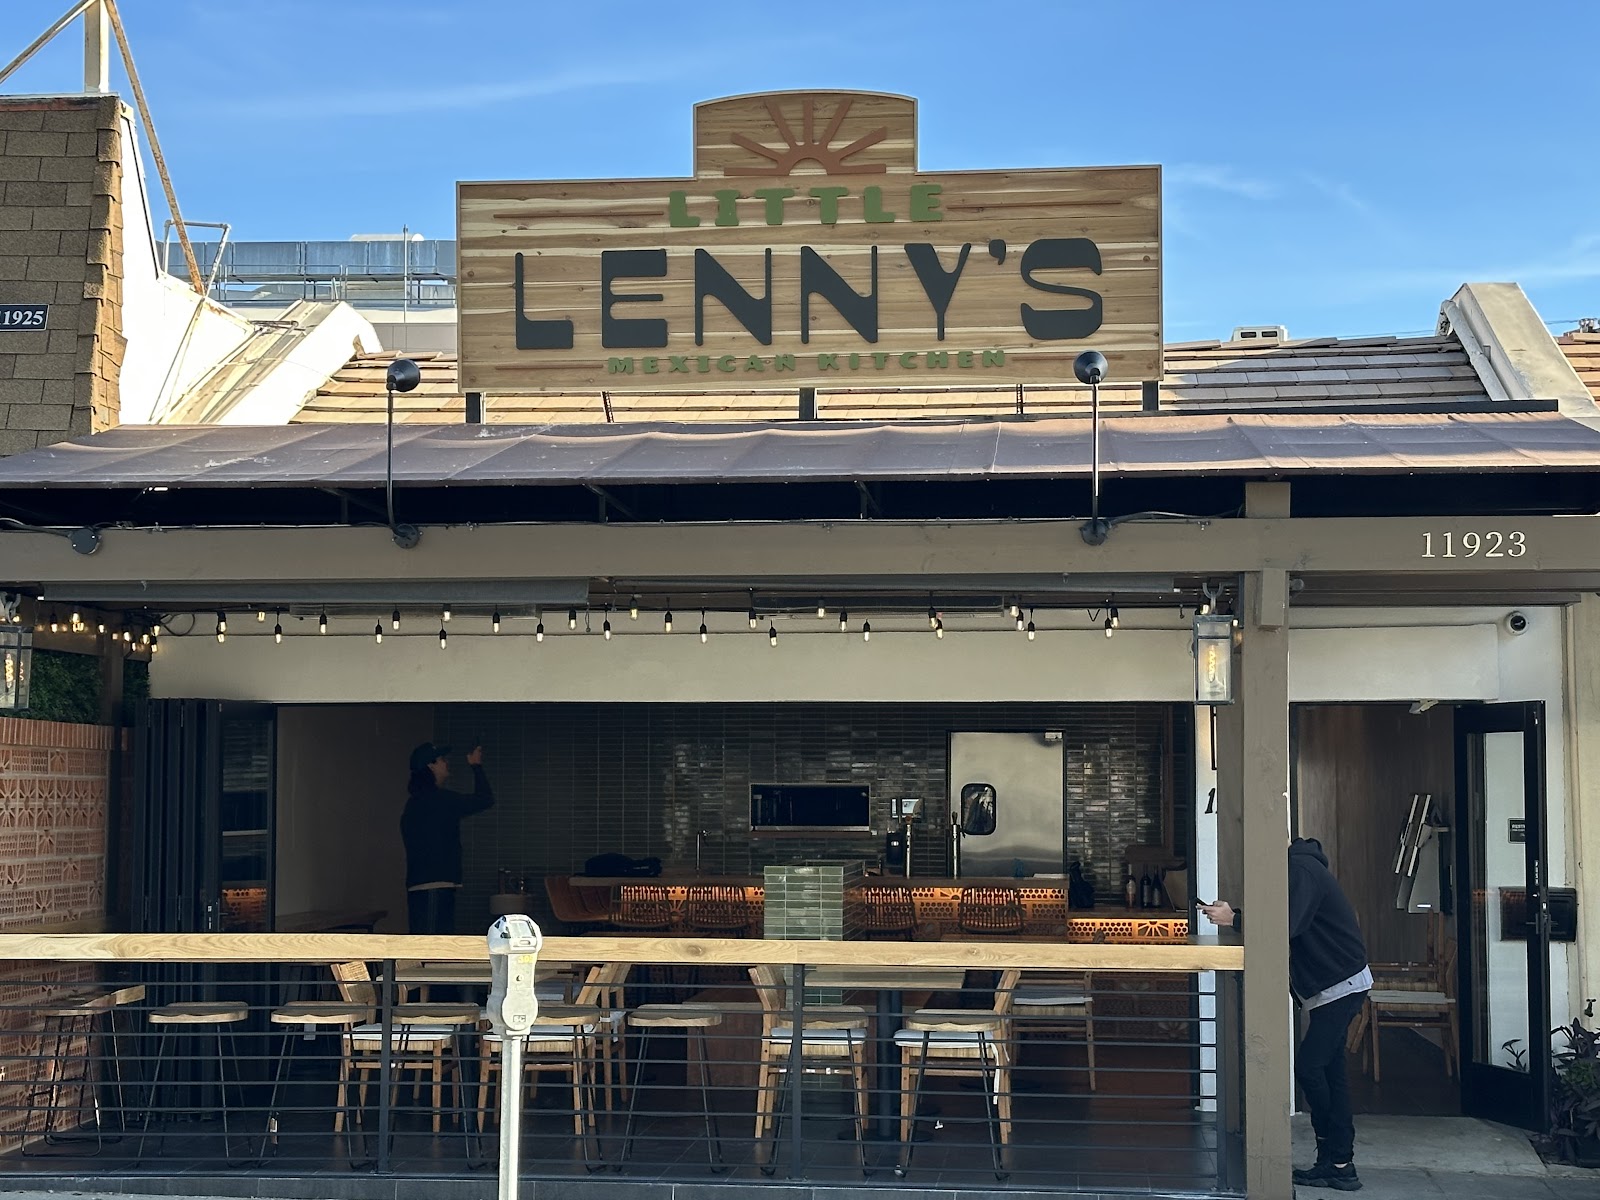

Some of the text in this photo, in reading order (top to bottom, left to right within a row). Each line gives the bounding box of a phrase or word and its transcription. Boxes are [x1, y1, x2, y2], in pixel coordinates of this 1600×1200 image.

[669, 184, 944, 227] LITTLE
[515, 237, 1102, 349] LENNY'S
[0, 310, 44, 325] 1925
[608, 350, 1005, 374] MEXICAN KITCHEN
[1421, 531, 1526, 558] 11923
